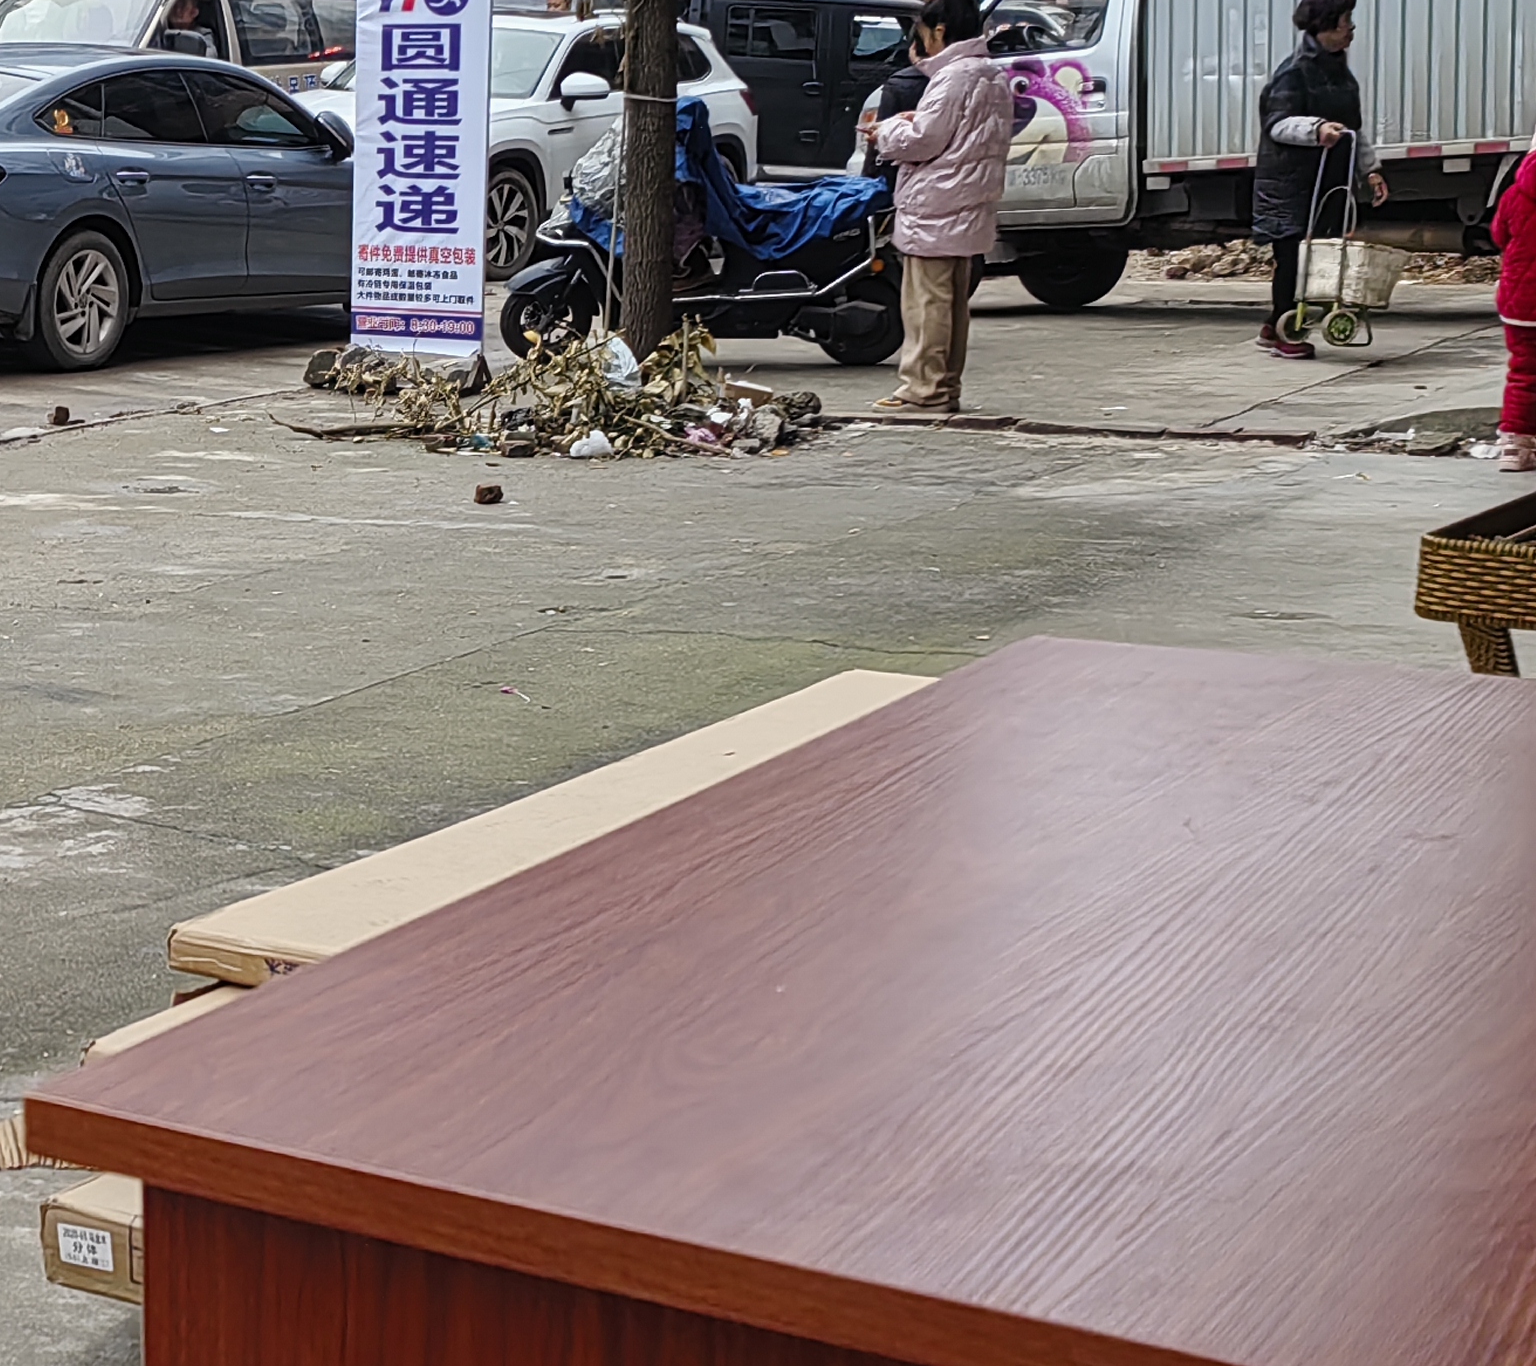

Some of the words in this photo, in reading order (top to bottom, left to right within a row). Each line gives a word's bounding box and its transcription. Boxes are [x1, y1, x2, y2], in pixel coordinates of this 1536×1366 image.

[375, 23, 463, 235] 圆通速递
[357, 243, 477, 266] 寄件免费提供真空包装
